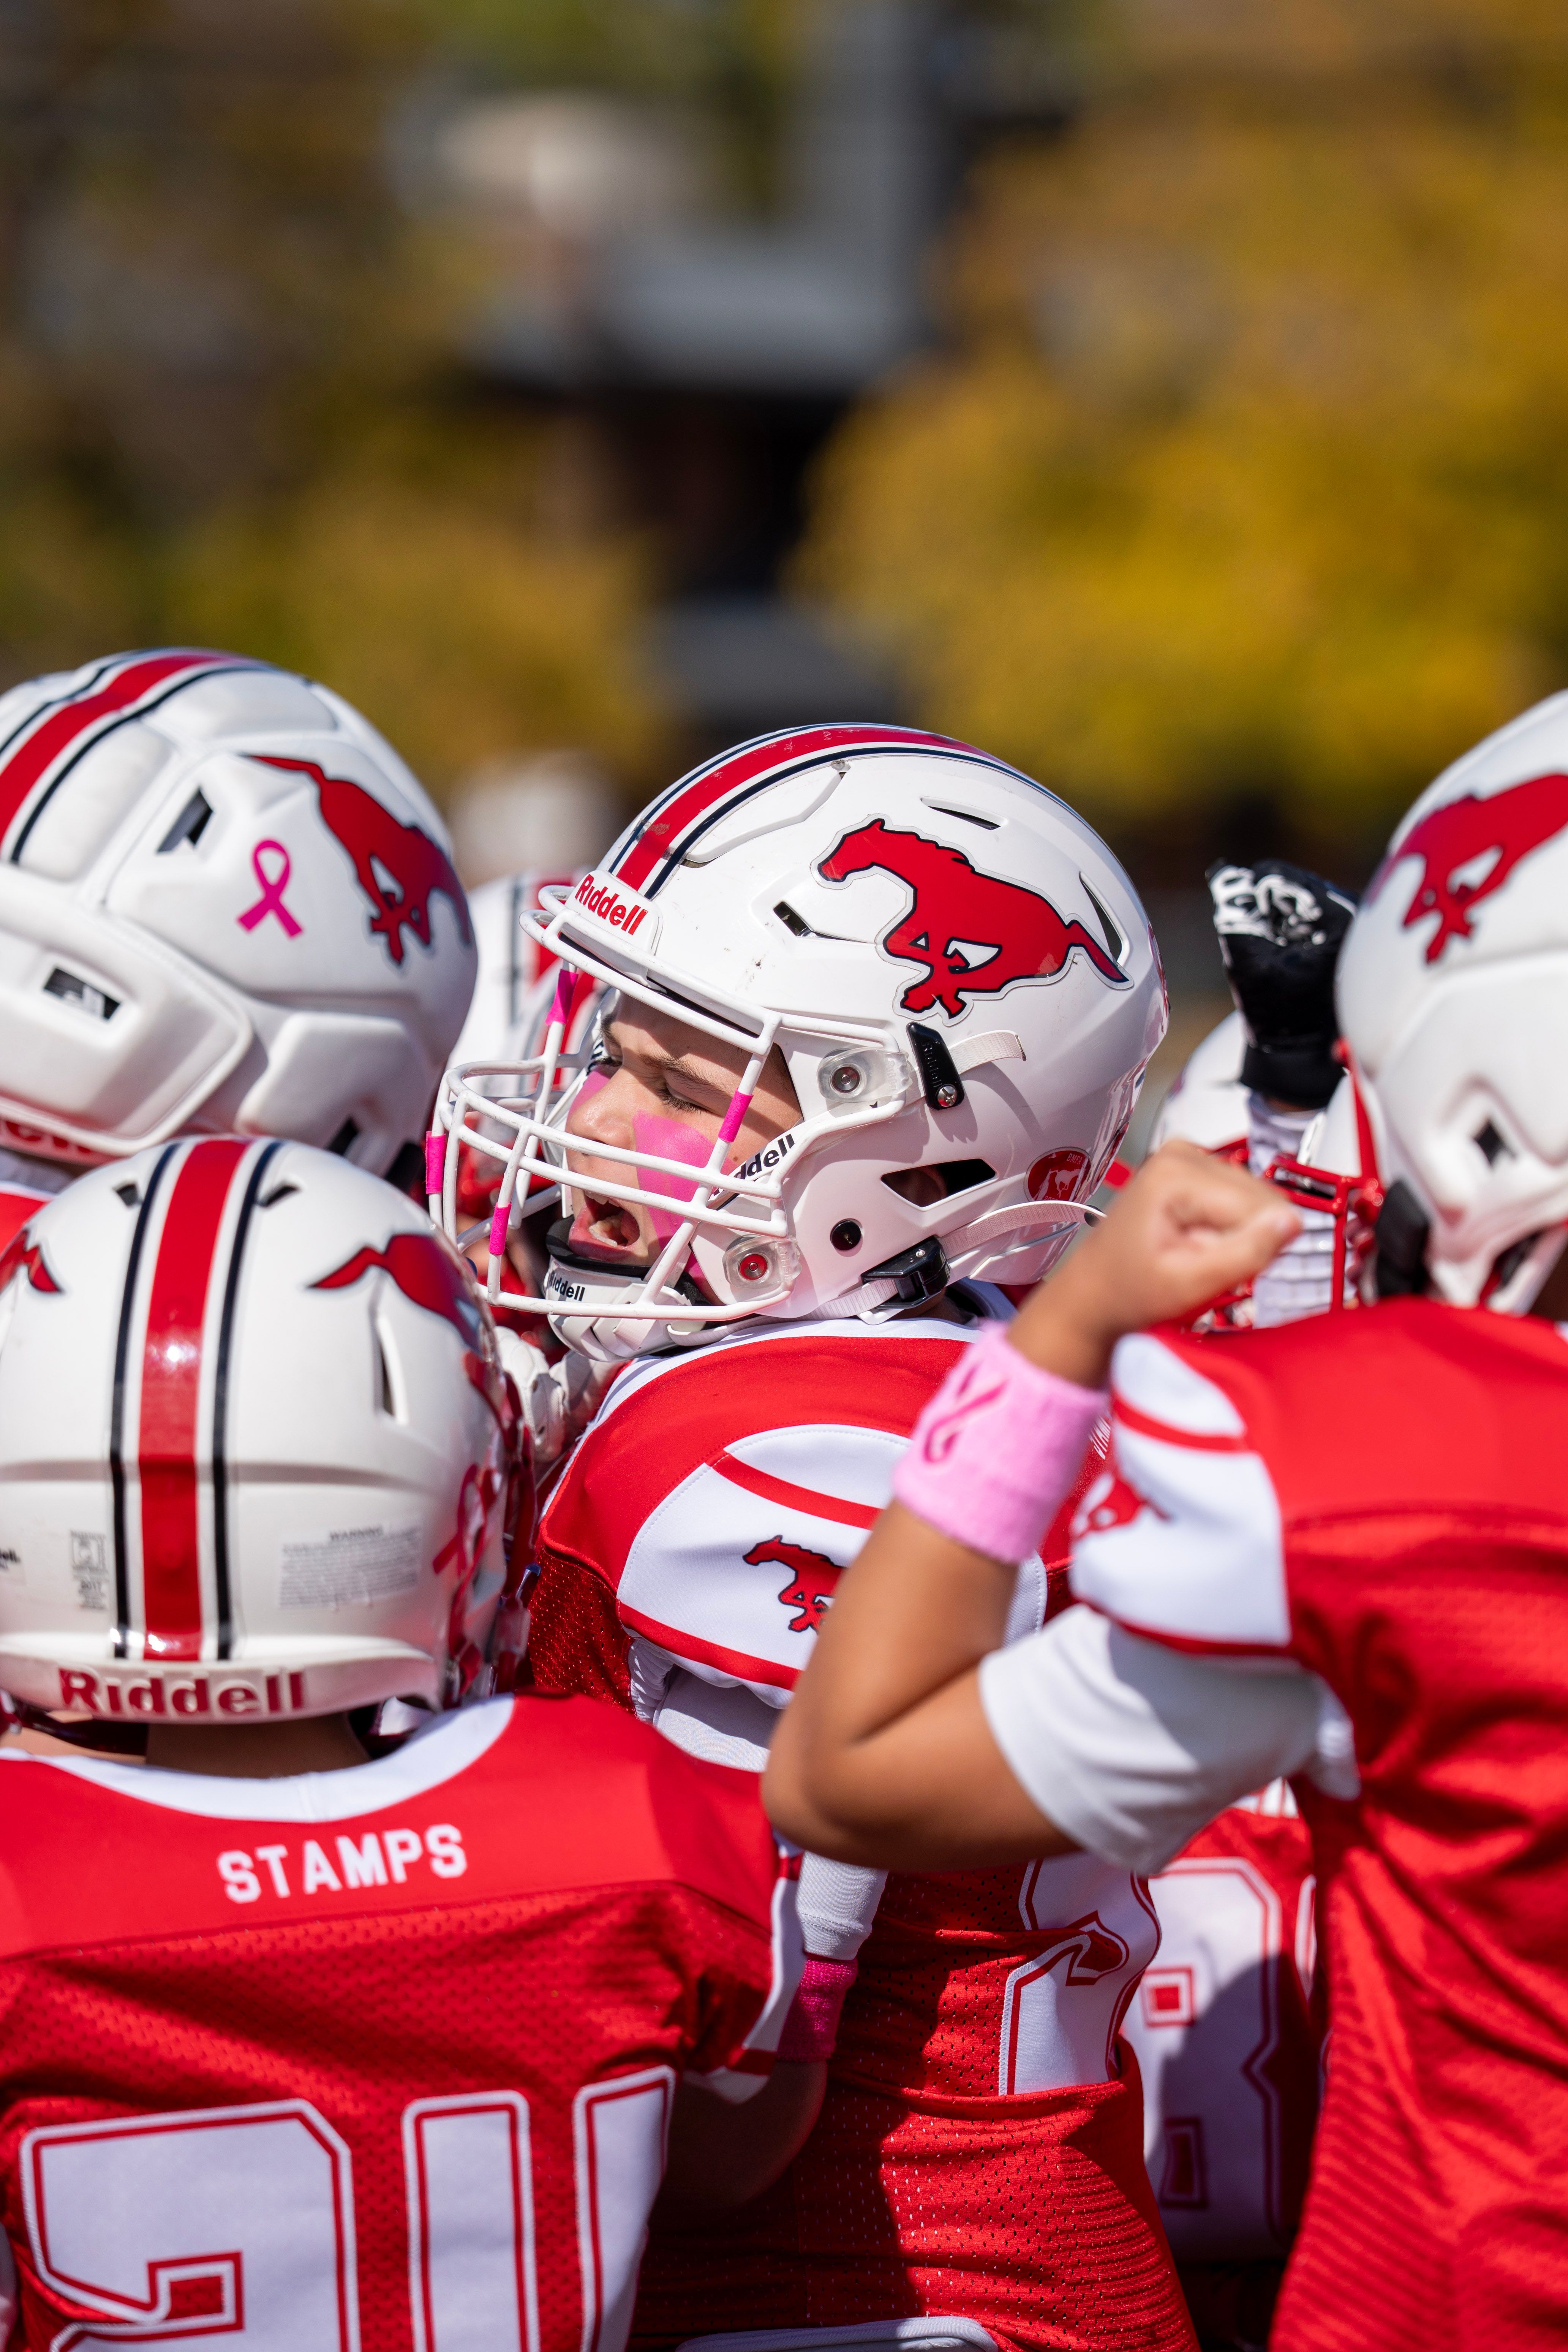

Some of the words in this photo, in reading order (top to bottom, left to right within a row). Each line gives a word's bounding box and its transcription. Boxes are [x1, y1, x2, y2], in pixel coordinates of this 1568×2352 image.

[574, 874, 649, 936] Riddell
[722, 1133, 795, 1187] ddell
[1066, 1153, 1083, 1165] BMFA
[58, 1668, 303, 1713] Riddell
[217, 1823, 468, 1904] STAMPS
